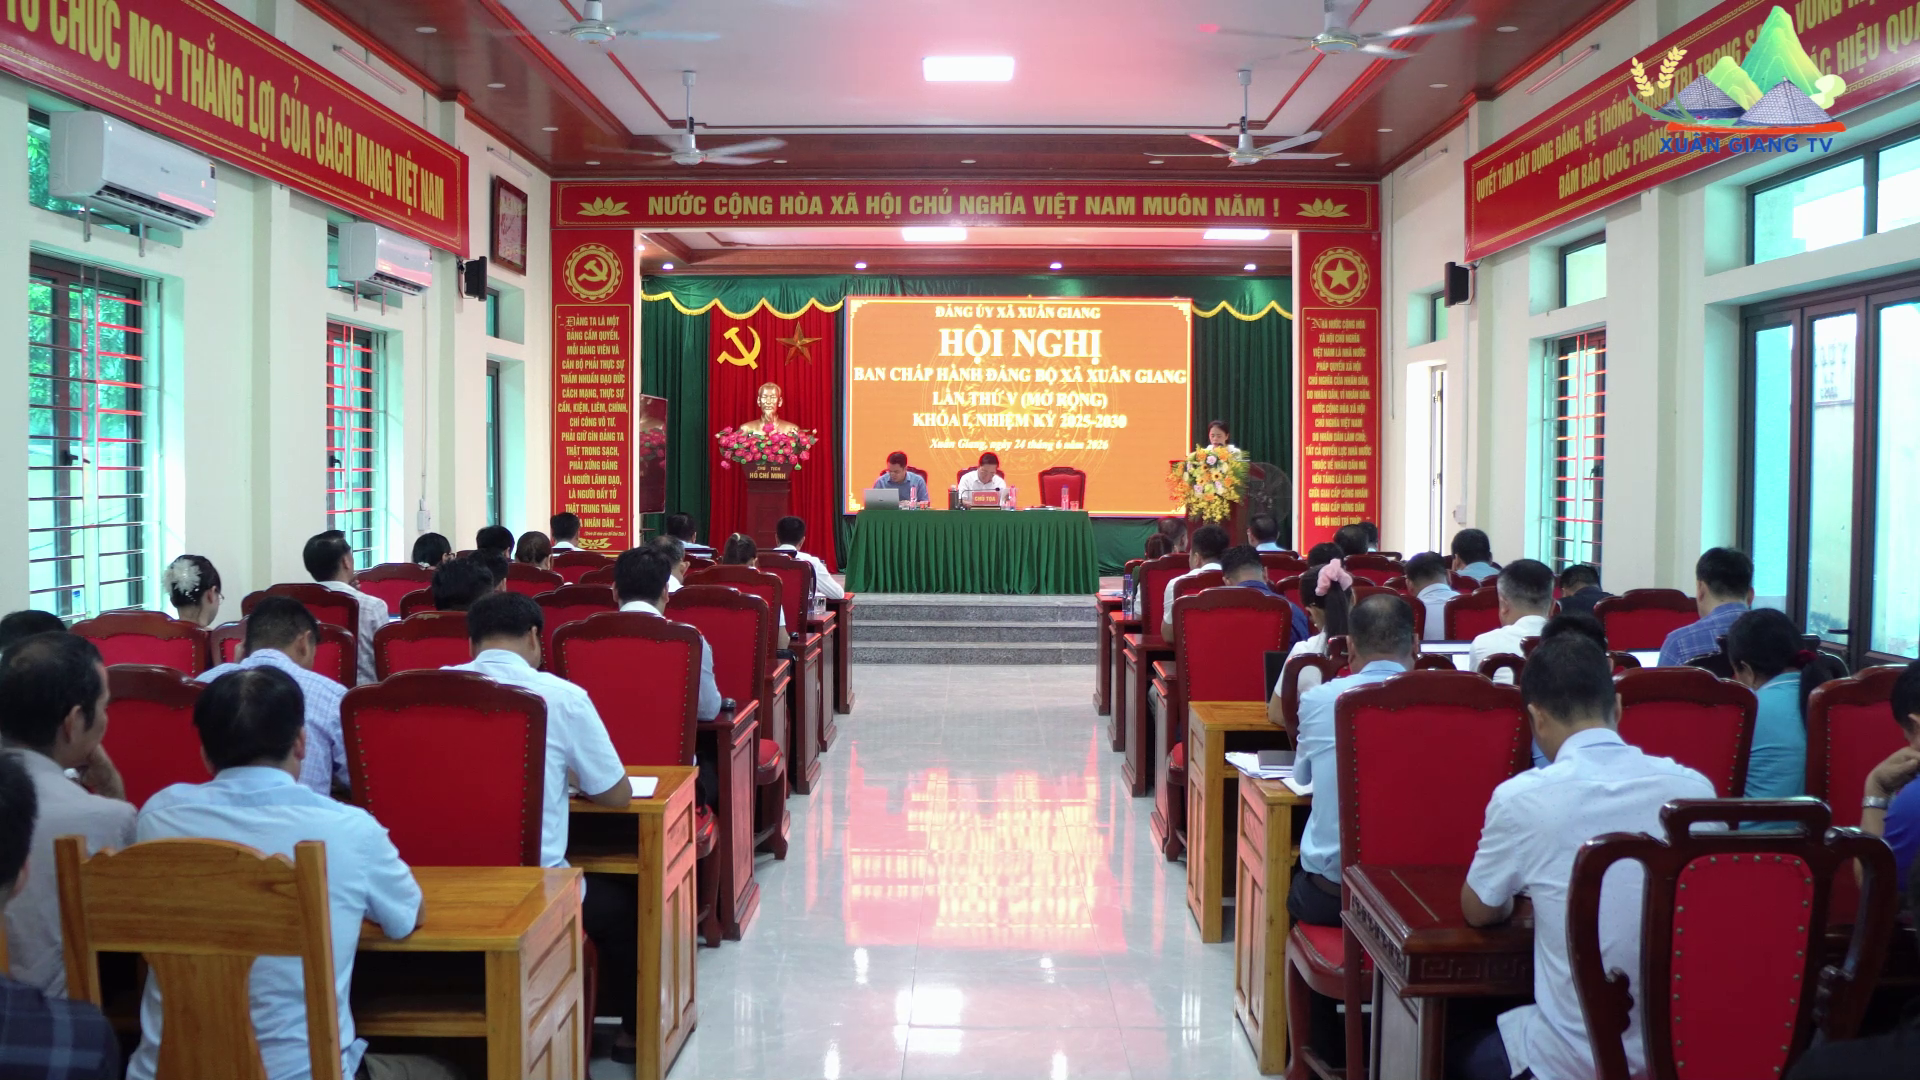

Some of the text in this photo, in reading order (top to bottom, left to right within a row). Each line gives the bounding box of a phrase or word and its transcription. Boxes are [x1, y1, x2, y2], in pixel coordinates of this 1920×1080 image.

[129, 11, 173, 106] MỌI
[179, 33, 244, 128] THẮNG
[249, 75, 275, 152] LỢI
[280, 75, 311, 159] CỦA
[316, 106, 352, 178] CÁCH
[356, 133, 392, 199] MẠNG
[395, 151, 418, 216] VIỆT
[420, 167, 444, 221] NAM
[1559, 164, 1579, 199] ĐẢM
[1582, 153, 1600, 189] BẢO
[1603, 137, 1630, 181] QUỐC
[1837, 22, 1880, 75] HIỆU
[1476, 167, 1497, 203] QUYẾT
[1498, 162, 1513, 190] TÂM
[1515, 152, 1530, 181] XÂY
[1532, 140, 1553, 174] DỰNG
[1556, 125, 1583, 160] ĐẢNG,
[1584, 111, 1597, 146] HỆ
[1599, 94, 1633, 136] THỐNG
[648, 188, 1280, 219] NƯỚC CỘNG HÒA XÃ HỘI CHỦ NGHĨA VIỆT NAM MUÔN NĂM !
[935, 304, 1101, 319] ĐẢNG ỦY XÃ XUÂN GIANG
[590, 316, 596, 326] TA
[598, 315, 605, 326] LÀ
[606, 315, 619, 327] MỘT
[567, 329, 583, 340] ĐẢNG
[580, 342, 596, 354] ĐẢNG
[597, 344, 610, 354] VIÊN
[612, 344, 619, 354] VÀ
[938, 323, 1103, 365] HỘI NGHỊ
[576, 358, 583, 371] BỘ
[585, 356, 599, 369] PHẢI
[600, 359, 614, 371] THỰC
[616, 359, 625, 371] SỰ
[853, 364, 1187, 386] BAN CHẤP HÀNH ĐẢNG BỘ XÃ XUÂN GIANG
[562, 387, 625, 399] CÁCH MẠNG, THỰC SỰ
[932, 388, 1108, 411] LẦN THỨ V (MỞ RỘNG)
[570, 416, 580, 427] CHÍ
[581, 416, 597, 427] CÔNG
[598, 416, 606, 427] VÔ
[912, 408, 959, 427] KHÓA
[975, 411, 1029, 430] NHIỆM
[1033, 410, 1056, 428] KỲ
[1059, 414, 1128, 429] 2025-2030
[561, 429, 624, 441] PHẢI GIỮ GÌN ĐẢNG TA
[929, 437, 955, 449] Xuân
[1014, 439, 1026, 449] 24
[566, 445, 619, 458] THẬT TRONG SẠCH,
[569, 457, 618, 470] PHẢI XỨNG ĐÁNG
[564, 473, 571, 484] LÀ
[572, 473, 590, 484] NGƯỜI
[591, 474, 607, 484] LÃNH
[749, 470, 758, 479] HỒ
[569, 488, 576, 499] LÀ
[577, 487, 595, 499] NGƯỜI
[581, 504, 600, 514] TRUNG
[601, 503, 621, 514] THÀNH
[584, 517, 600, 528] NHÂN
